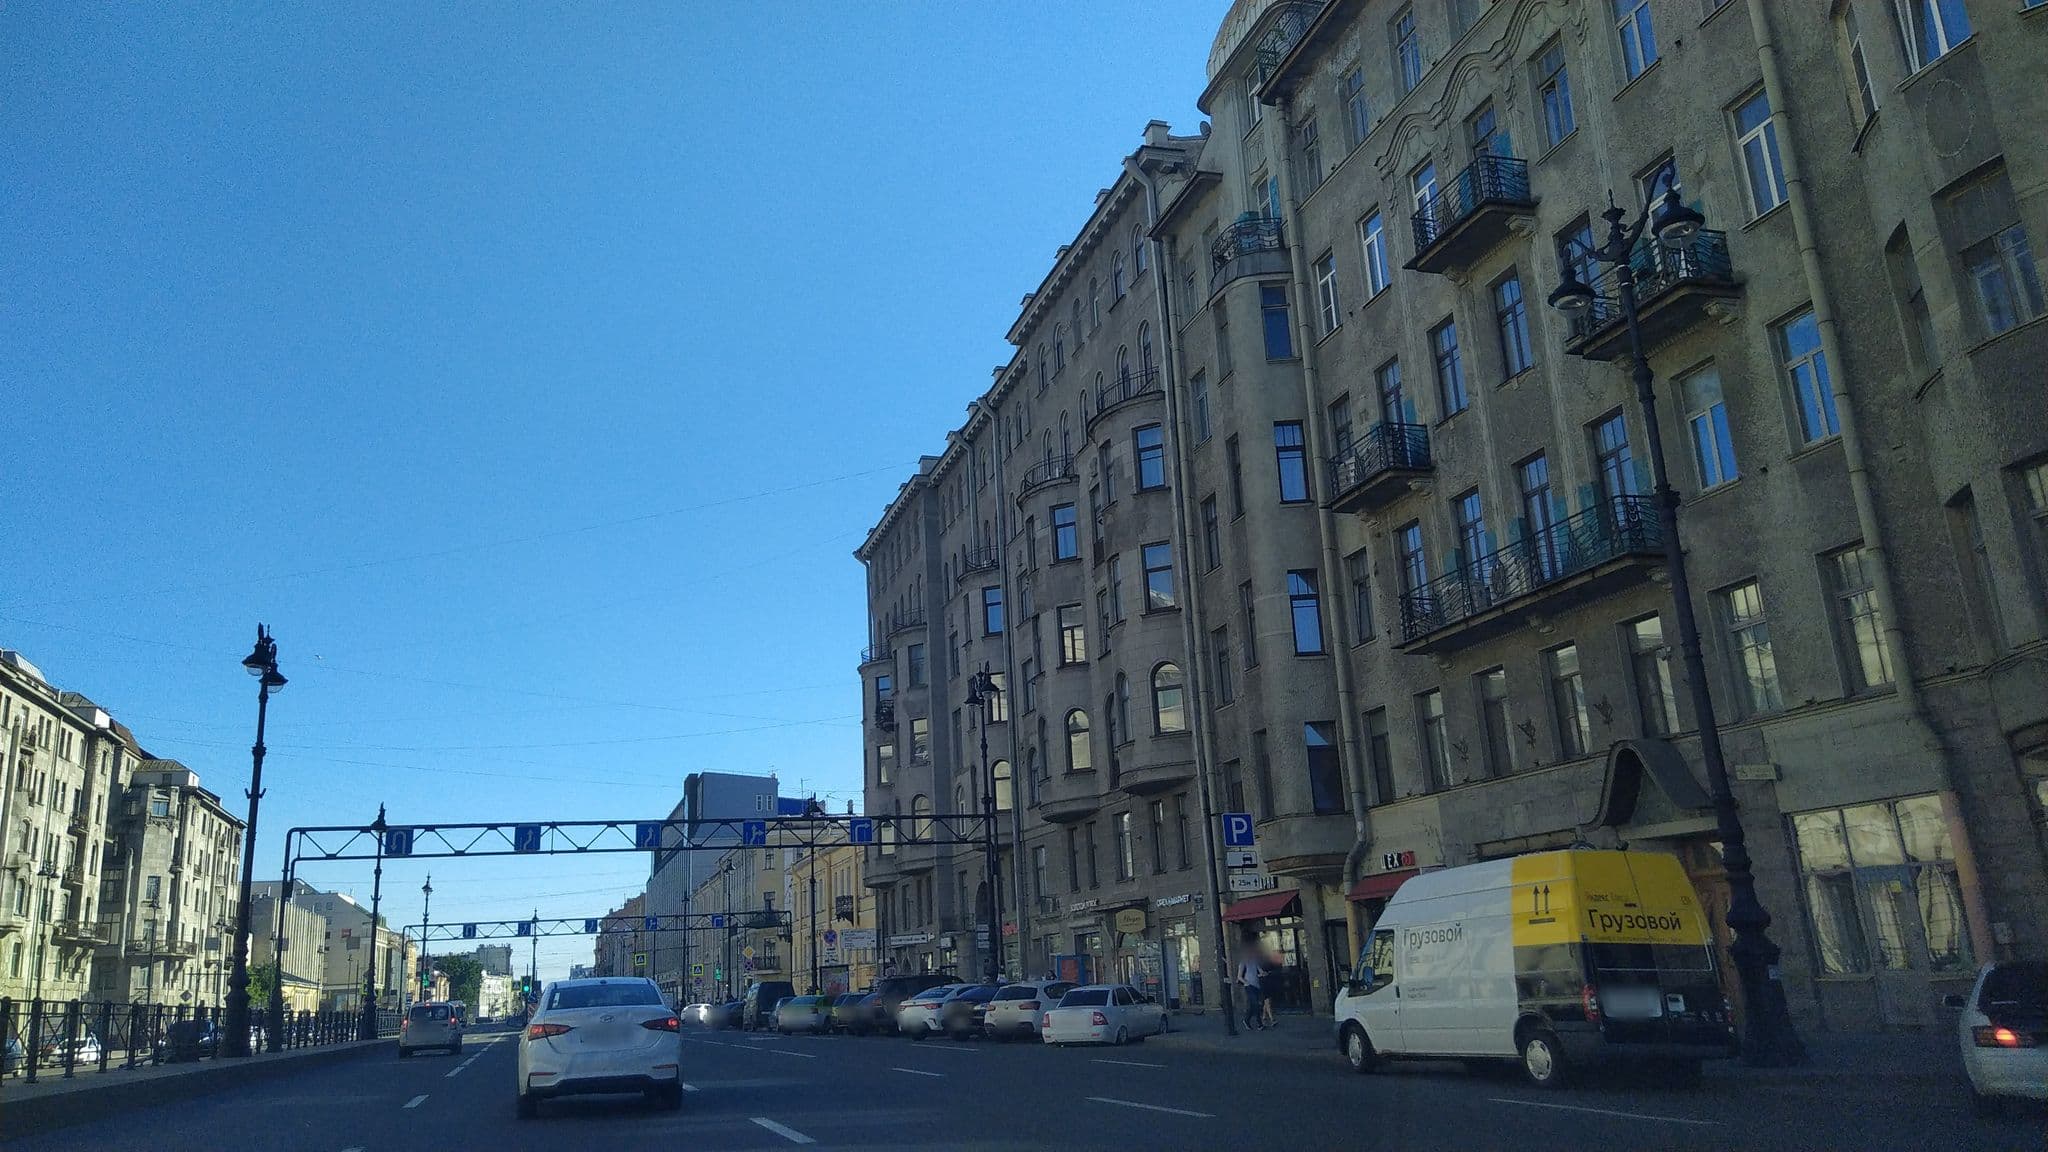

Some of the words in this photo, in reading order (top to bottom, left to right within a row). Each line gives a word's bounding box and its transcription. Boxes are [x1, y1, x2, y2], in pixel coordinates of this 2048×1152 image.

[1230, 817, 1248, 843] P
[1588, 908, 1682, 933] Грузовой
[1404, 922, 1462, 950] Грузовой
